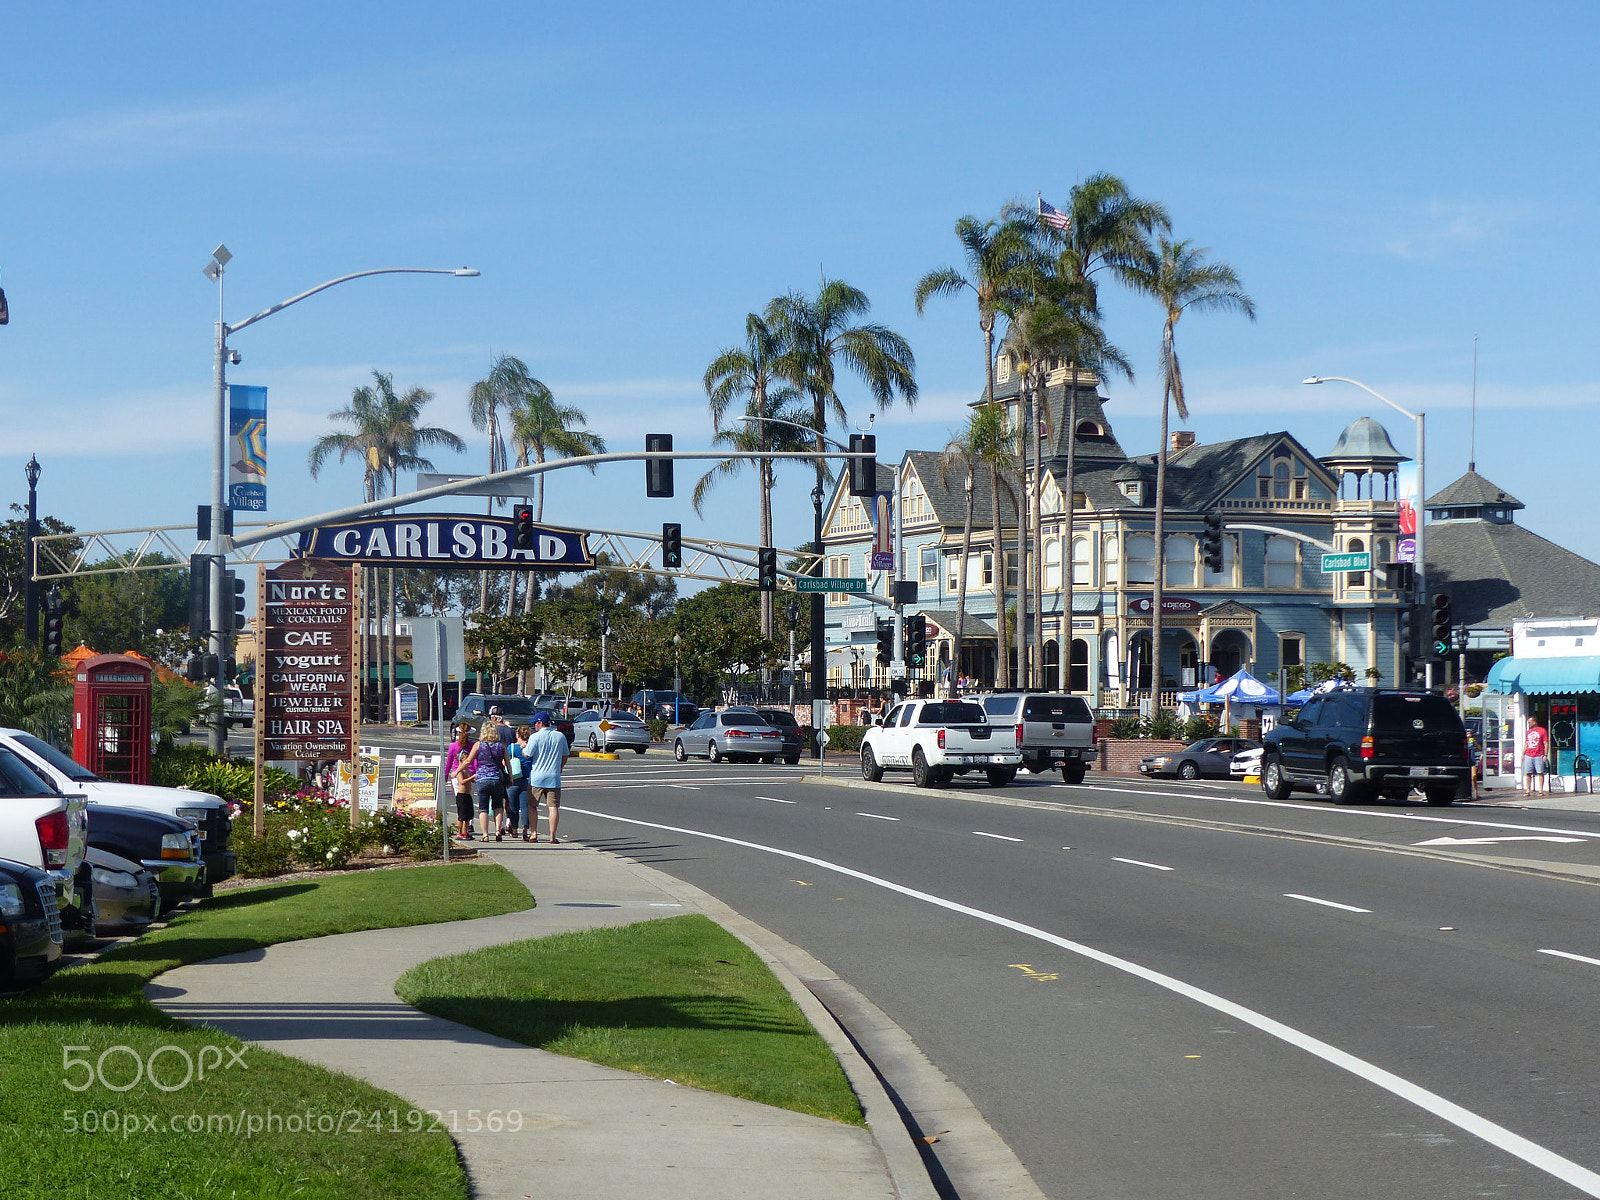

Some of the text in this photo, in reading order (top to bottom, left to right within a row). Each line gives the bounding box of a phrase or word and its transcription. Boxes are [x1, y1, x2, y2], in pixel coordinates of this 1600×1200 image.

[232, 496, 264, 509] Village
[1324, 556, 1368, 568] Carlsbad Blvd
[798, 580, 864, 590] Carlsbad Village Dr
[271, 583, 347, 600] Norte
[271, 607, 347, 615] MEXICAN FOOD
[1167, 602, 1191, 610] DIEGO
[276, 615, 342, 624] & COCKTAILS
[284, 631, 332, 646] CAFE
[274, 654, 342, 669] yogurt
[271, 673, 345, 682] CALIFORNIA
[290, 682, 327, 691] WEAR
[599, 682, 612, 691] 30
[272, 697, 343, 707] JEWELER
[271, 720, 345, 735] HAIR SPA
[270, 741, 346, 751] Vacation Ownership
[295, 749, 321, 758] Center
